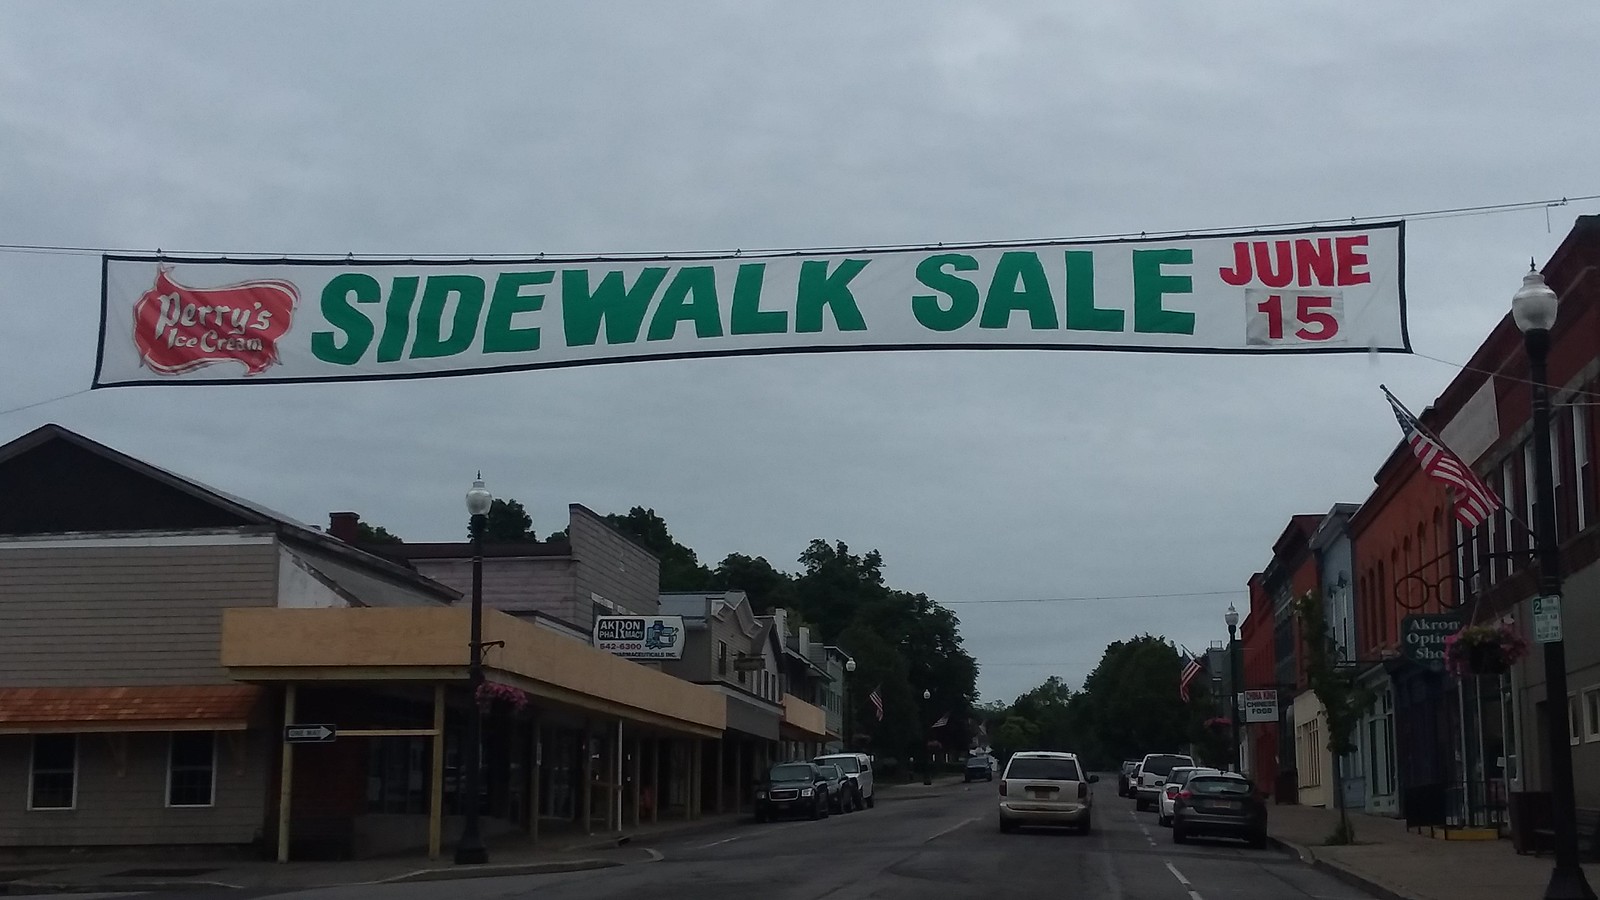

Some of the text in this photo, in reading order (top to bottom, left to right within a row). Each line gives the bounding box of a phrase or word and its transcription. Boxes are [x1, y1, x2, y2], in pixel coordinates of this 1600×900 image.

[1219, 235, 1370, 287] JUNE
[155, 291, 272, 340] Perry's
[311, 249, 1195, 365] SIDEWALK SALE
[1257, 295, 1339, 341] 15
[167, 328, 263, 352] Ice Cream
[1534, 601, 1540, 612] 2
[600, 620, 641, 632] AKRON
[1410, 618, 1459, 630] Akron
[599, 629, 643, 639] PHARMACY
[1415, 647, 1445, 660] Sho
